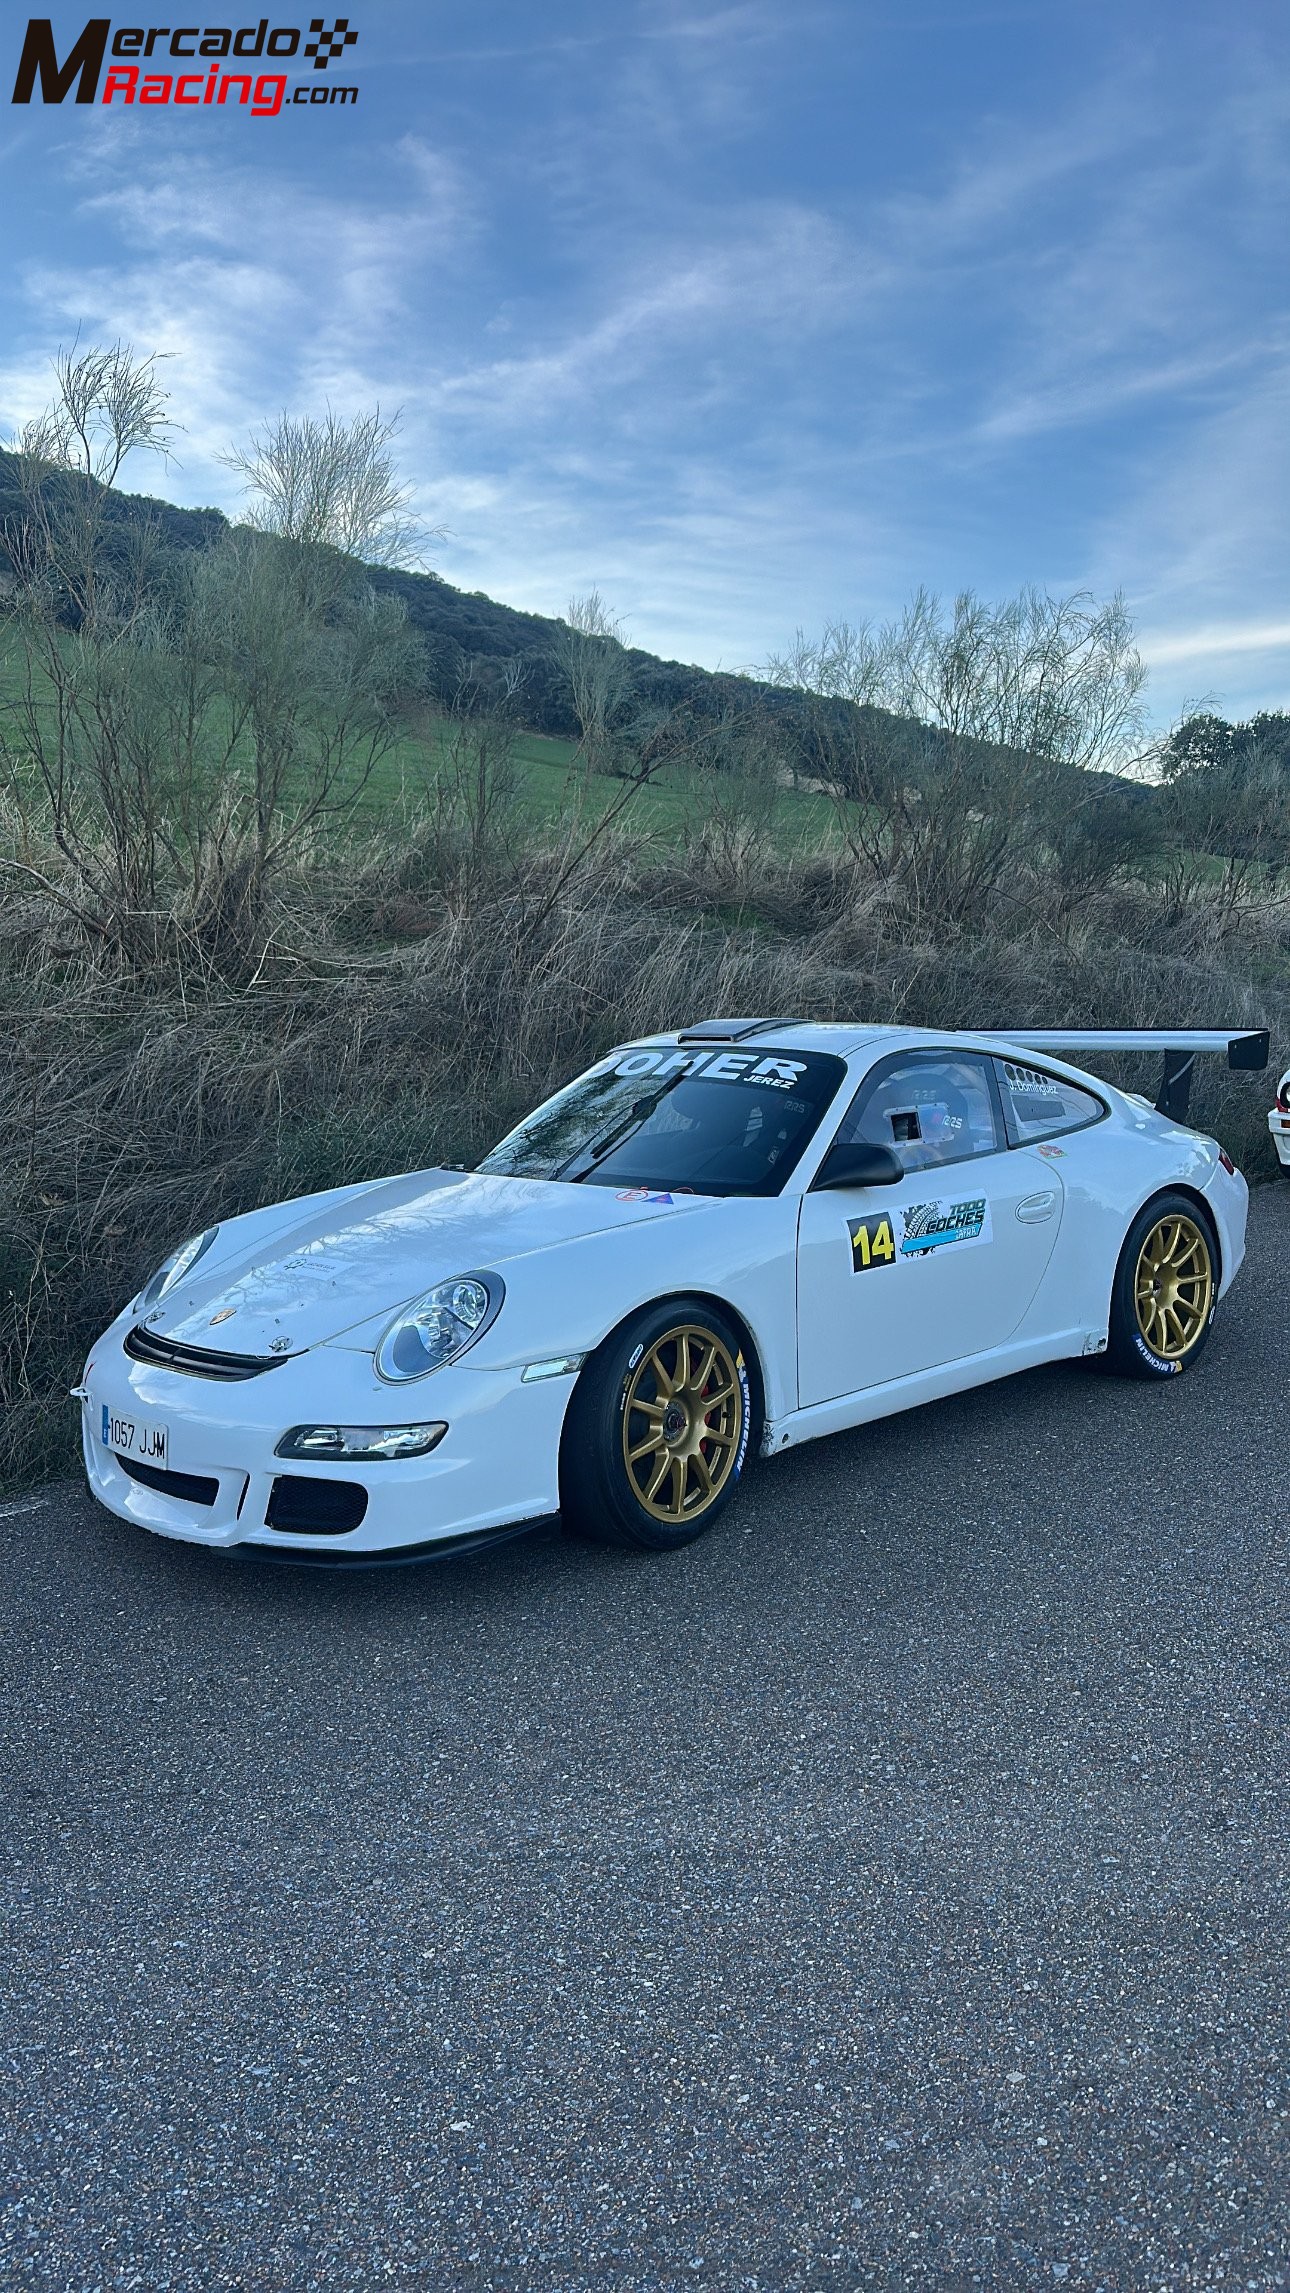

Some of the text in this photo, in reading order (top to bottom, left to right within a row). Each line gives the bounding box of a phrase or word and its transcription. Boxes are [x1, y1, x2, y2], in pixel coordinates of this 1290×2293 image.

[743, 1074, 795, 1089] JEREZ
[927, 1209, 985, 1233] COCHES
[853, 1221, 894, 1265] 14
[1136, 1338, 1169, 1372] MICHELIN
[110, 1417, 165, 1459] 1057 JJM
[736, 1383, 751, 1472] MICHELIN
